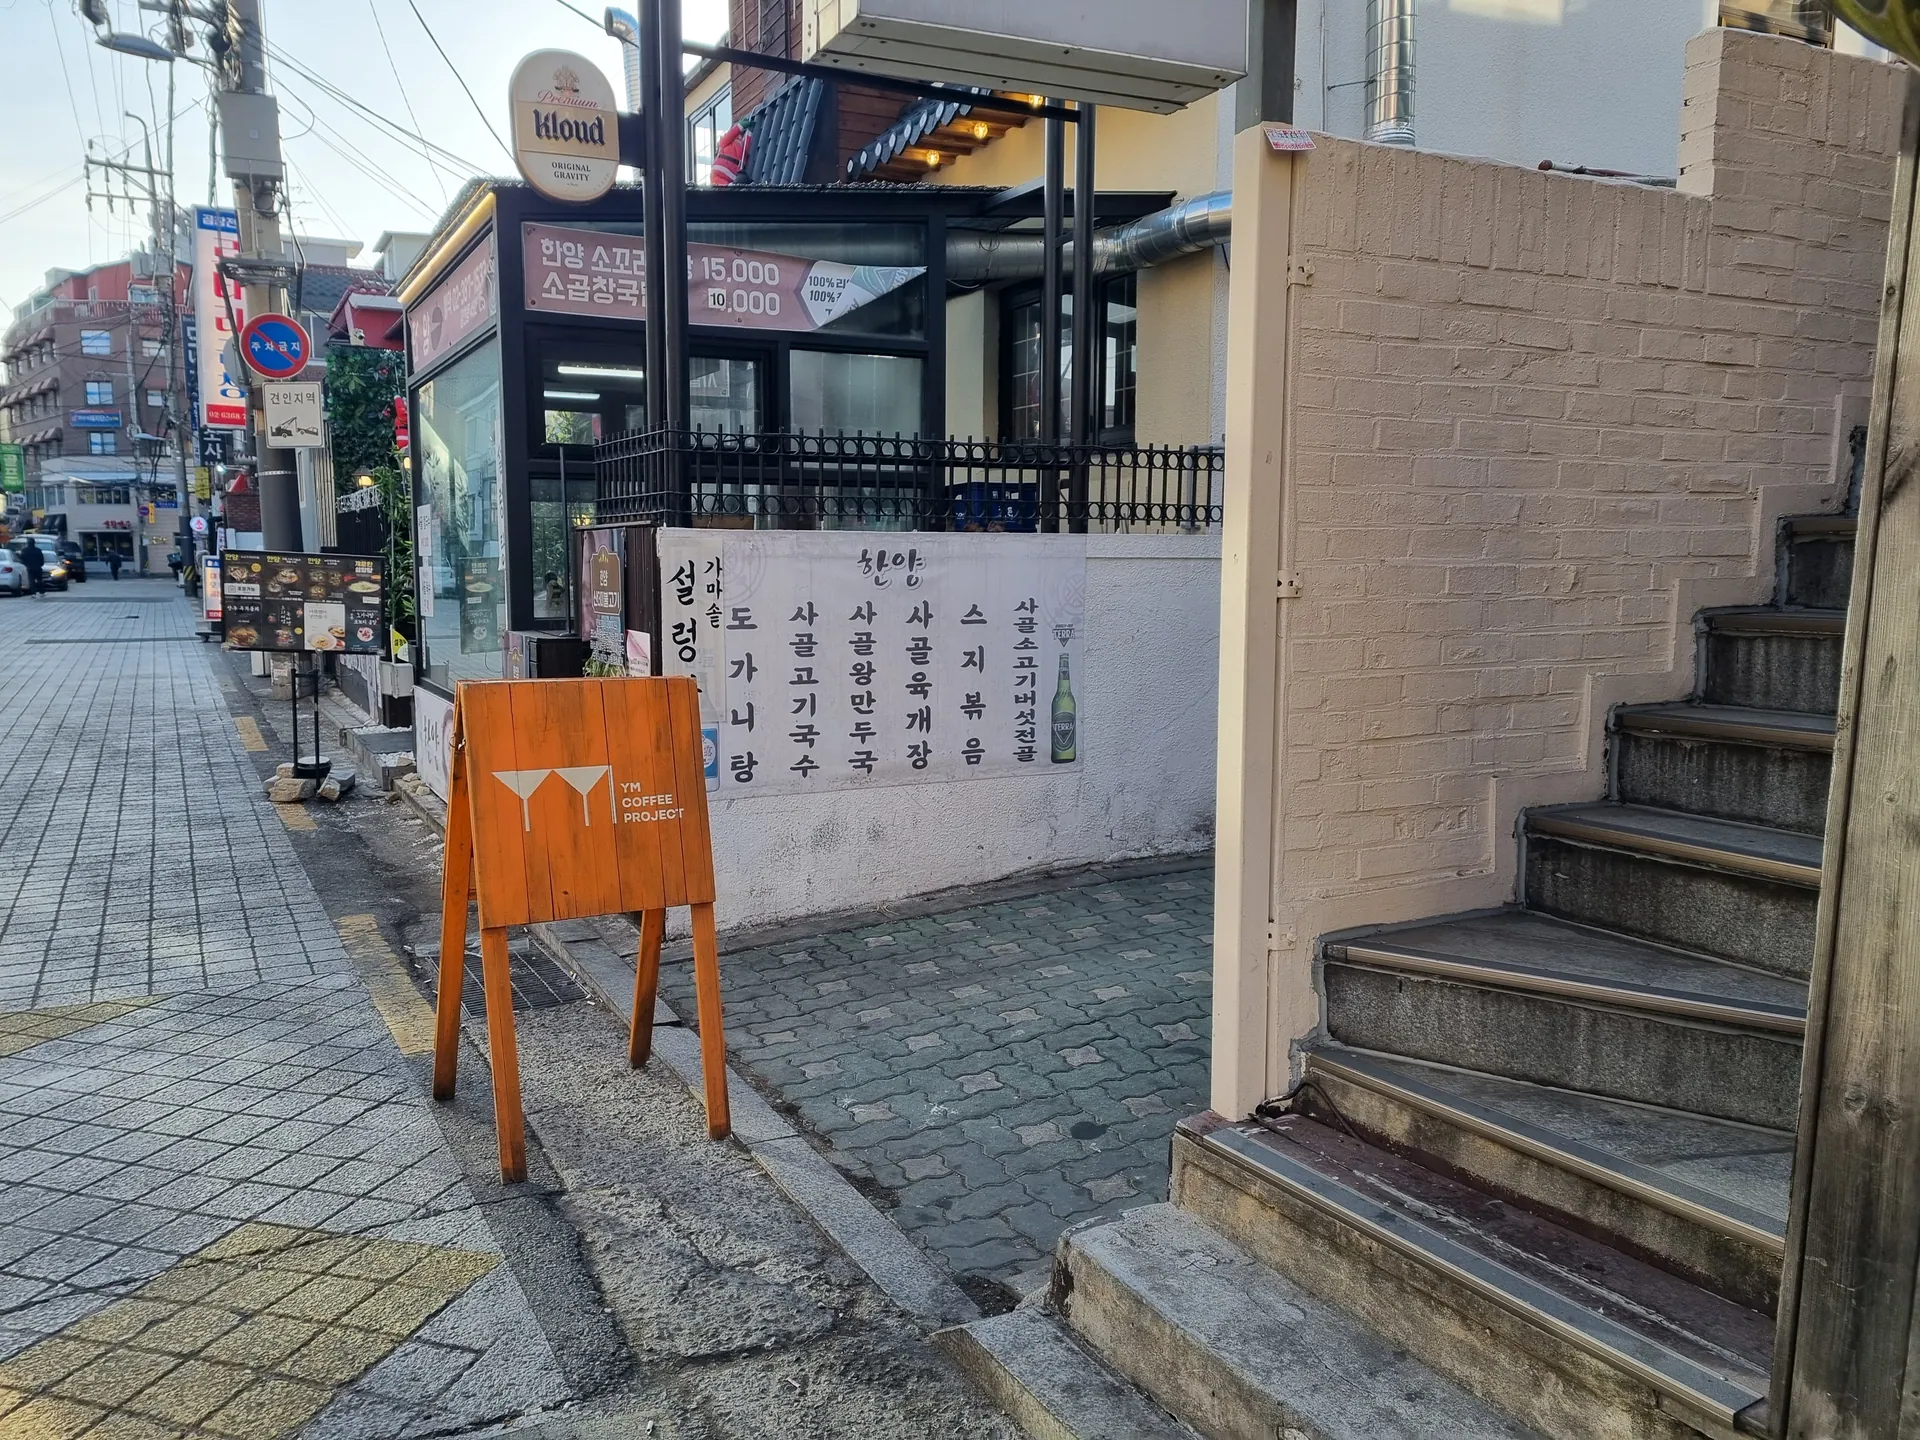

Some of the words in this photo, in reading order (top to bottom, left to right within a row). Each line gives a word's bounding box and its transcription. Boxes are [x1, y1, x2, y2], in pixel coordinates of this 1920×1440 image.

[538, 90, 599, 108] Premium
[533, 109, 606, 146] Kloud
[551, 161, 591, 172] ORIGINAL
[553, 171, 590, 181] GRAVITY
[540, 237, 585, 269] 한양
[541, 271, 646, 307] 소곱창국
[251, 341, 300, 352] 주차금지
[270, 392, 316, 405] 견인지역
[857, 548, 926, 587] 한양
[704, 556, 723, 629] 가마솥
[667, 560, 702, 693] 설렁
[1052, 628, 1075, 640] TERRA
[726, 607, 759, 783] 도가니탕
[789, 601, 821, 778] 사골고기국수
[848, 601, 878, 774] 사골왕만두국
[905, 600, 934, 769] 사골육개장
[960, 603, 987, 765] 스지볶음
[1012, 597, 1039, 762] 사골소고기버섯전골
[1053, 723, 1073, 732] TERRA
[620, 782, 641, 793] YM
[622, 794, 673, 808] COFFEE
[624, 808, 685, 823] PROJECT
